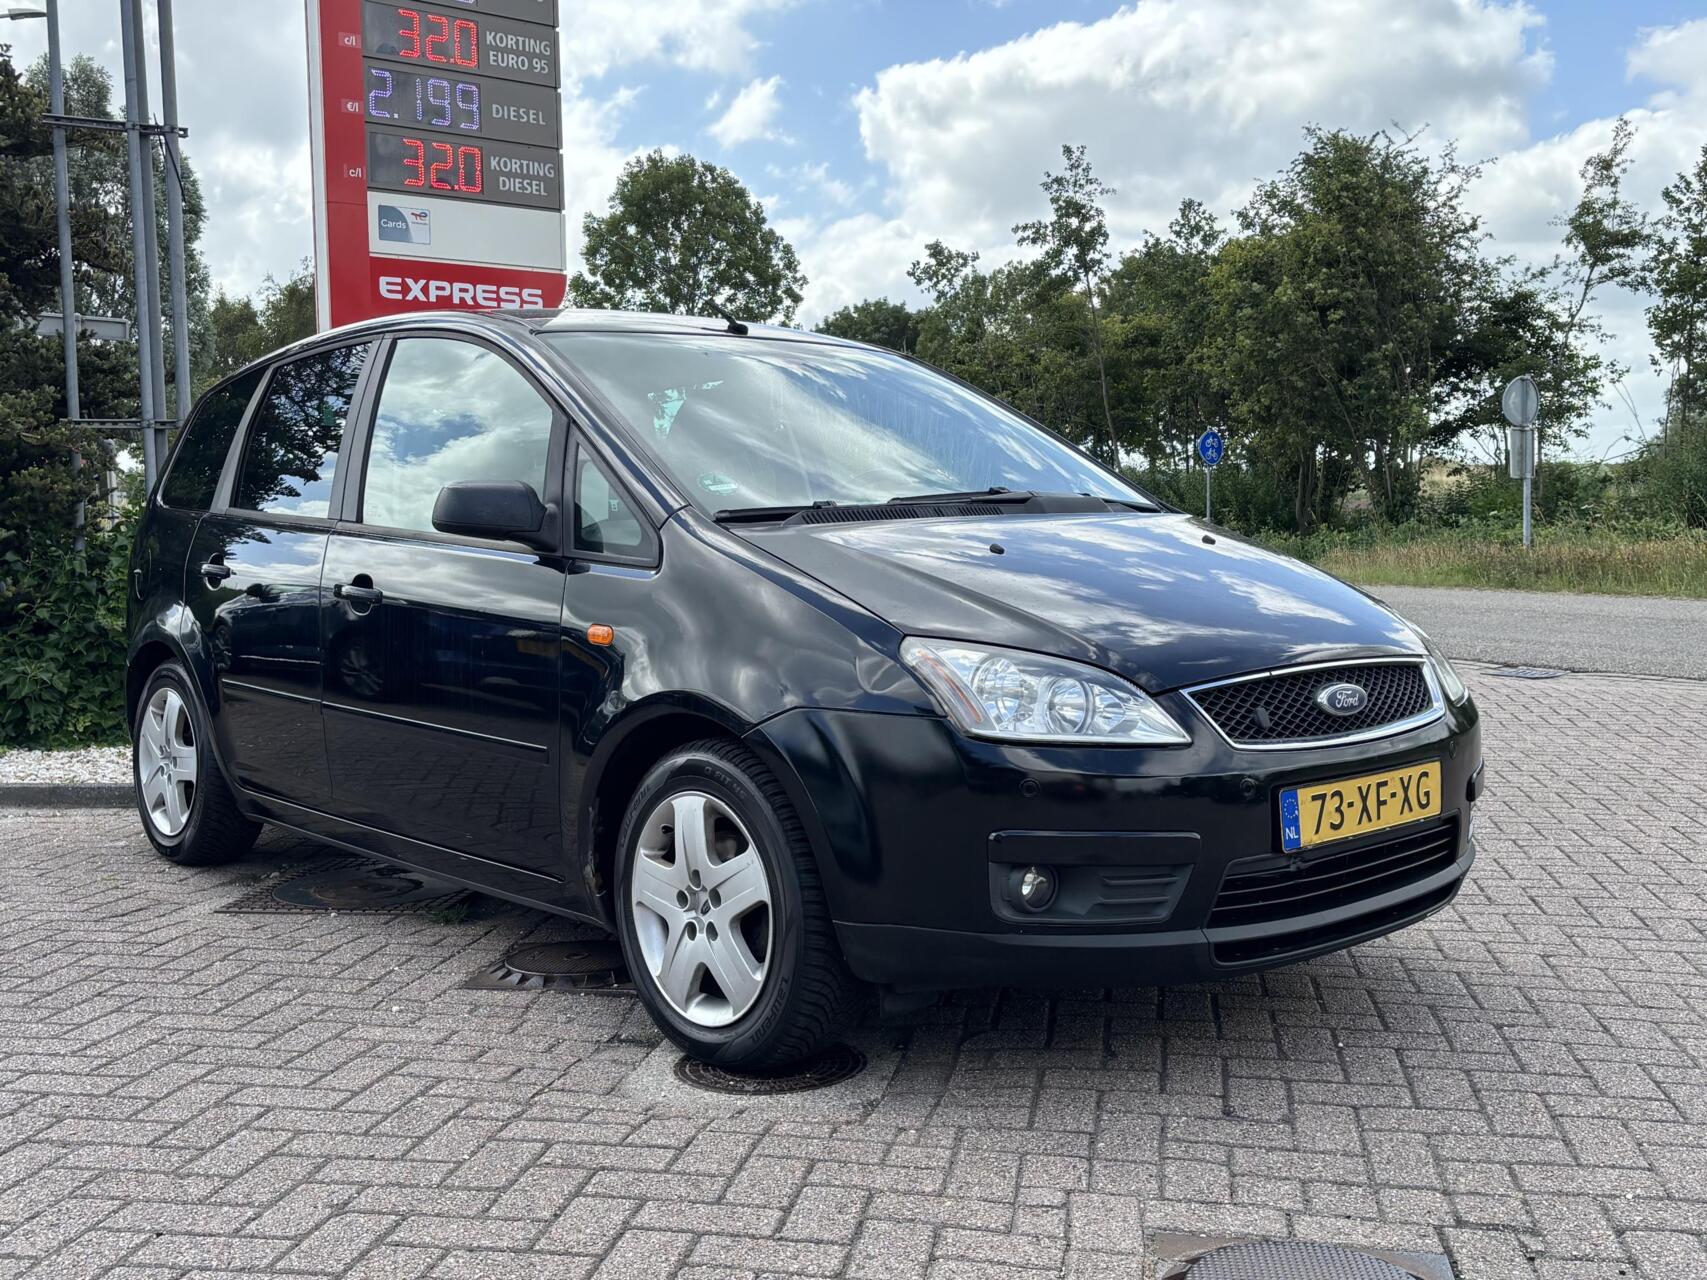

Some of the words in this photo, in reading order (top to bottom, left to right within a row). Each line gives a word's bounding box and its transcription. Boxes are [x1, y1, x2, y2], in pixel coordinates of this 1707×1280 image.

[486, 31, 551, 56] KORTING
[489, 54, 529, 71] EURO
[532, 59, 549, 74] 95
[368, 69, 480, 130] 2.199
[492, 104, 546, 126] DIESEL
[490, 156, 555, 178] KORTING
[499, 176, 548, 197] DIESEL
[380, 218, 407, 229] Cards
[379, 276, 543, 309] EXPRESS
[1335, 689, 1360, 708] Ford
[1311, 772, 1431, 836] 73-XF-XG
[1285, 826, 1299, 840] NL
